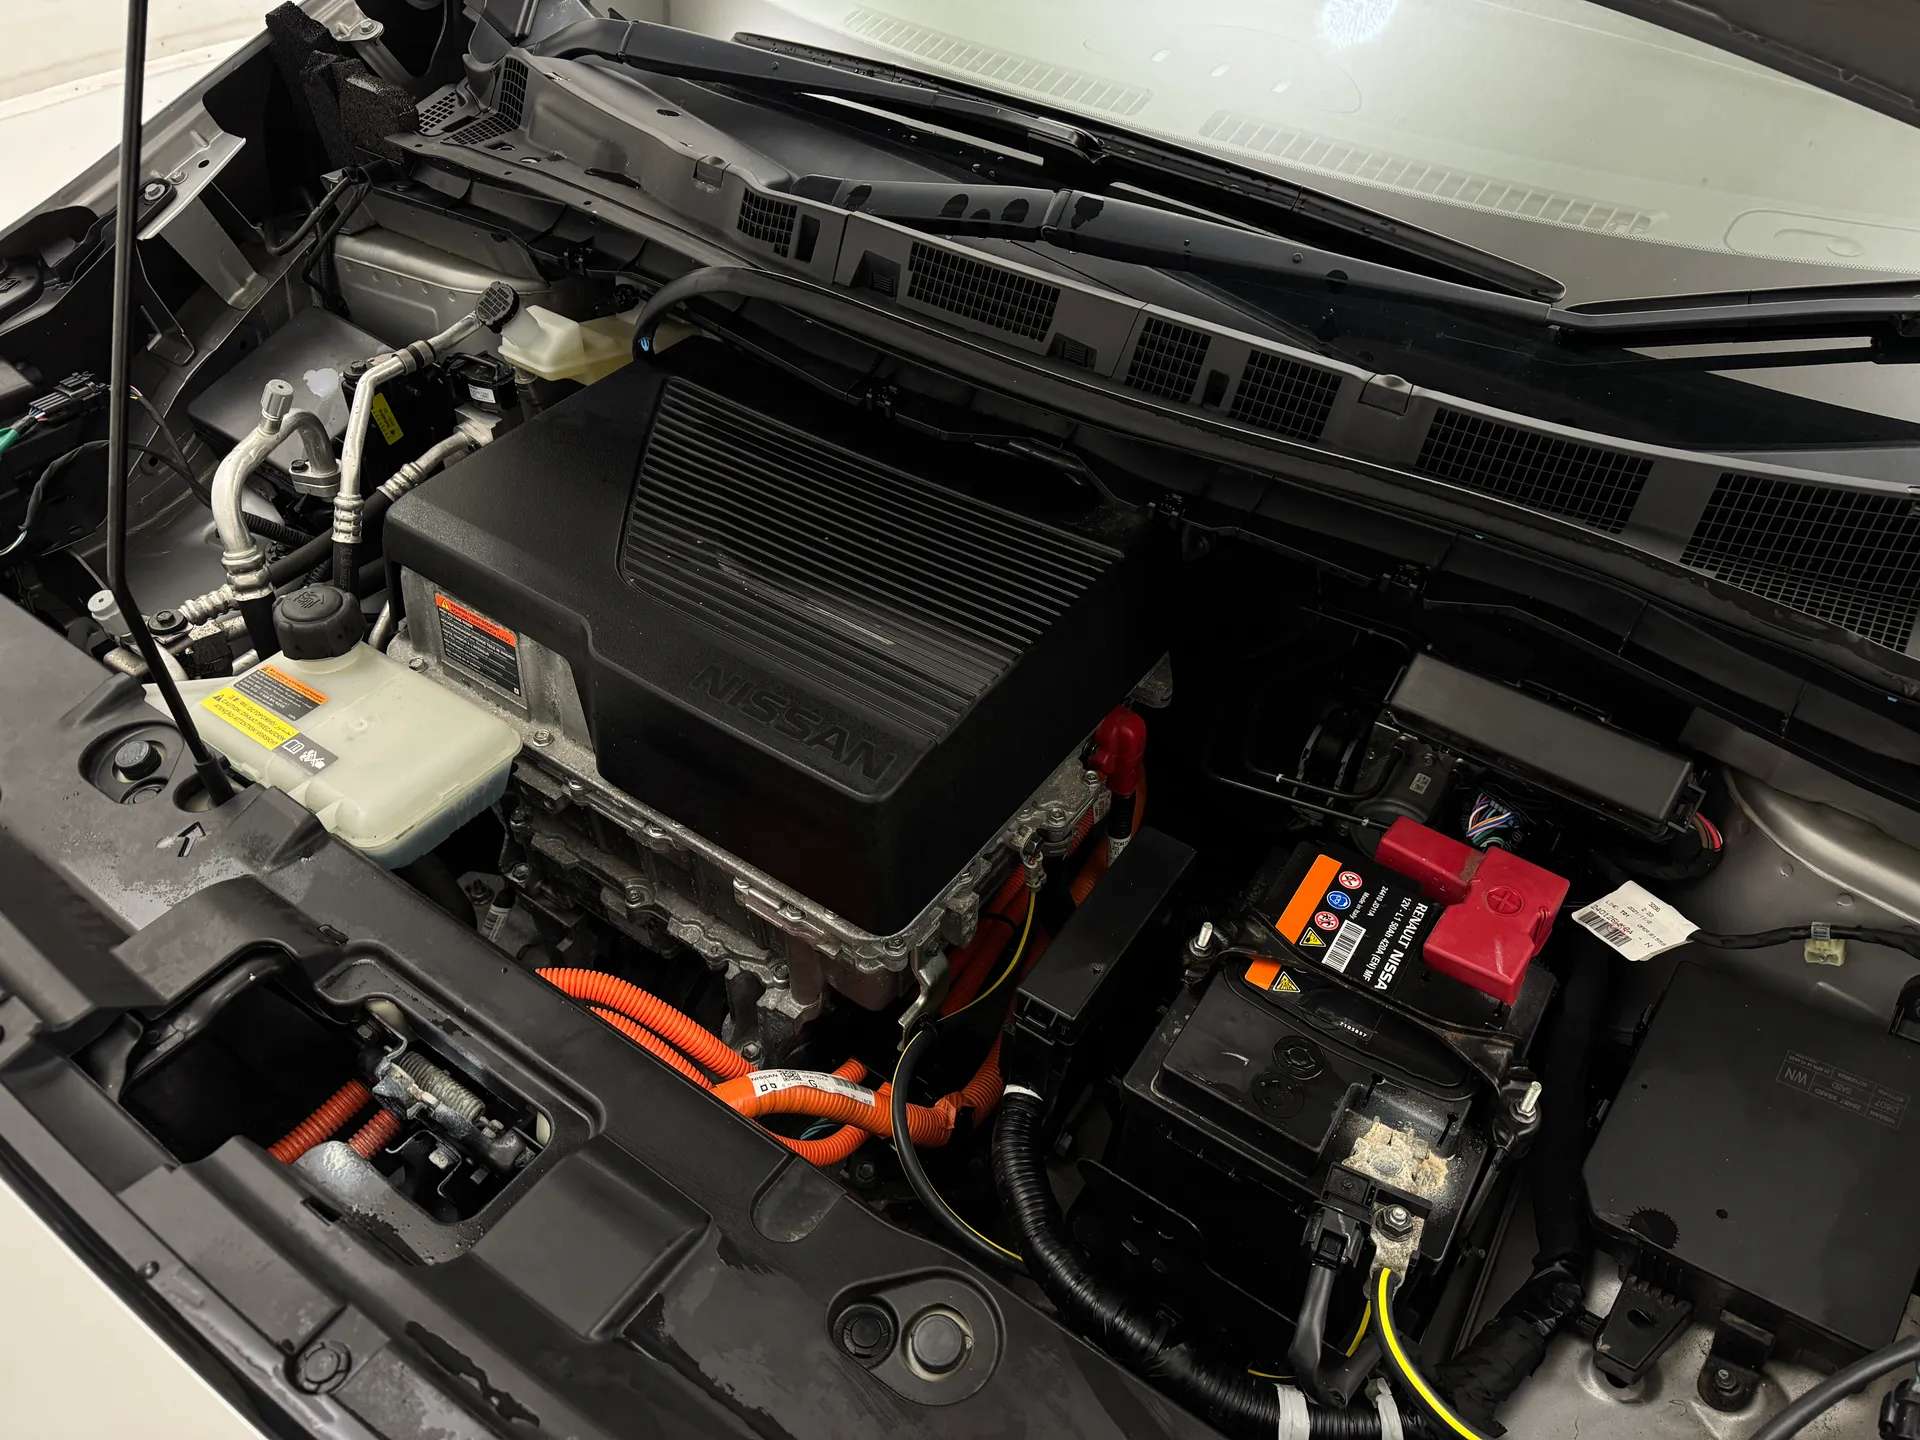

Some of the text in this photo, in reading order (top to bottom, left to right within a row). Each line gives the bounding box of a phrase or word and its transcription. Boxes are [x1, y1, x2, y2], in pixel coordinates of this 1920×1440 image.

[688, 663, 897, 784] NISSAN
[1360, 891, 1369, 905] Made
[1402, 897, 1412, 910] 12V
[1350, 908, 1360, 920] Italy
[1395, 911, 1403, 921] L1
[1385, 921, 1398, 938] 50Ah
[1400, 903, 1428, 949] RENAULT
[1375, 937, 1390, 955] 420A
[1366, 953, 1381, 969] (EN)
[1362, 969, 1373, 981] MF
